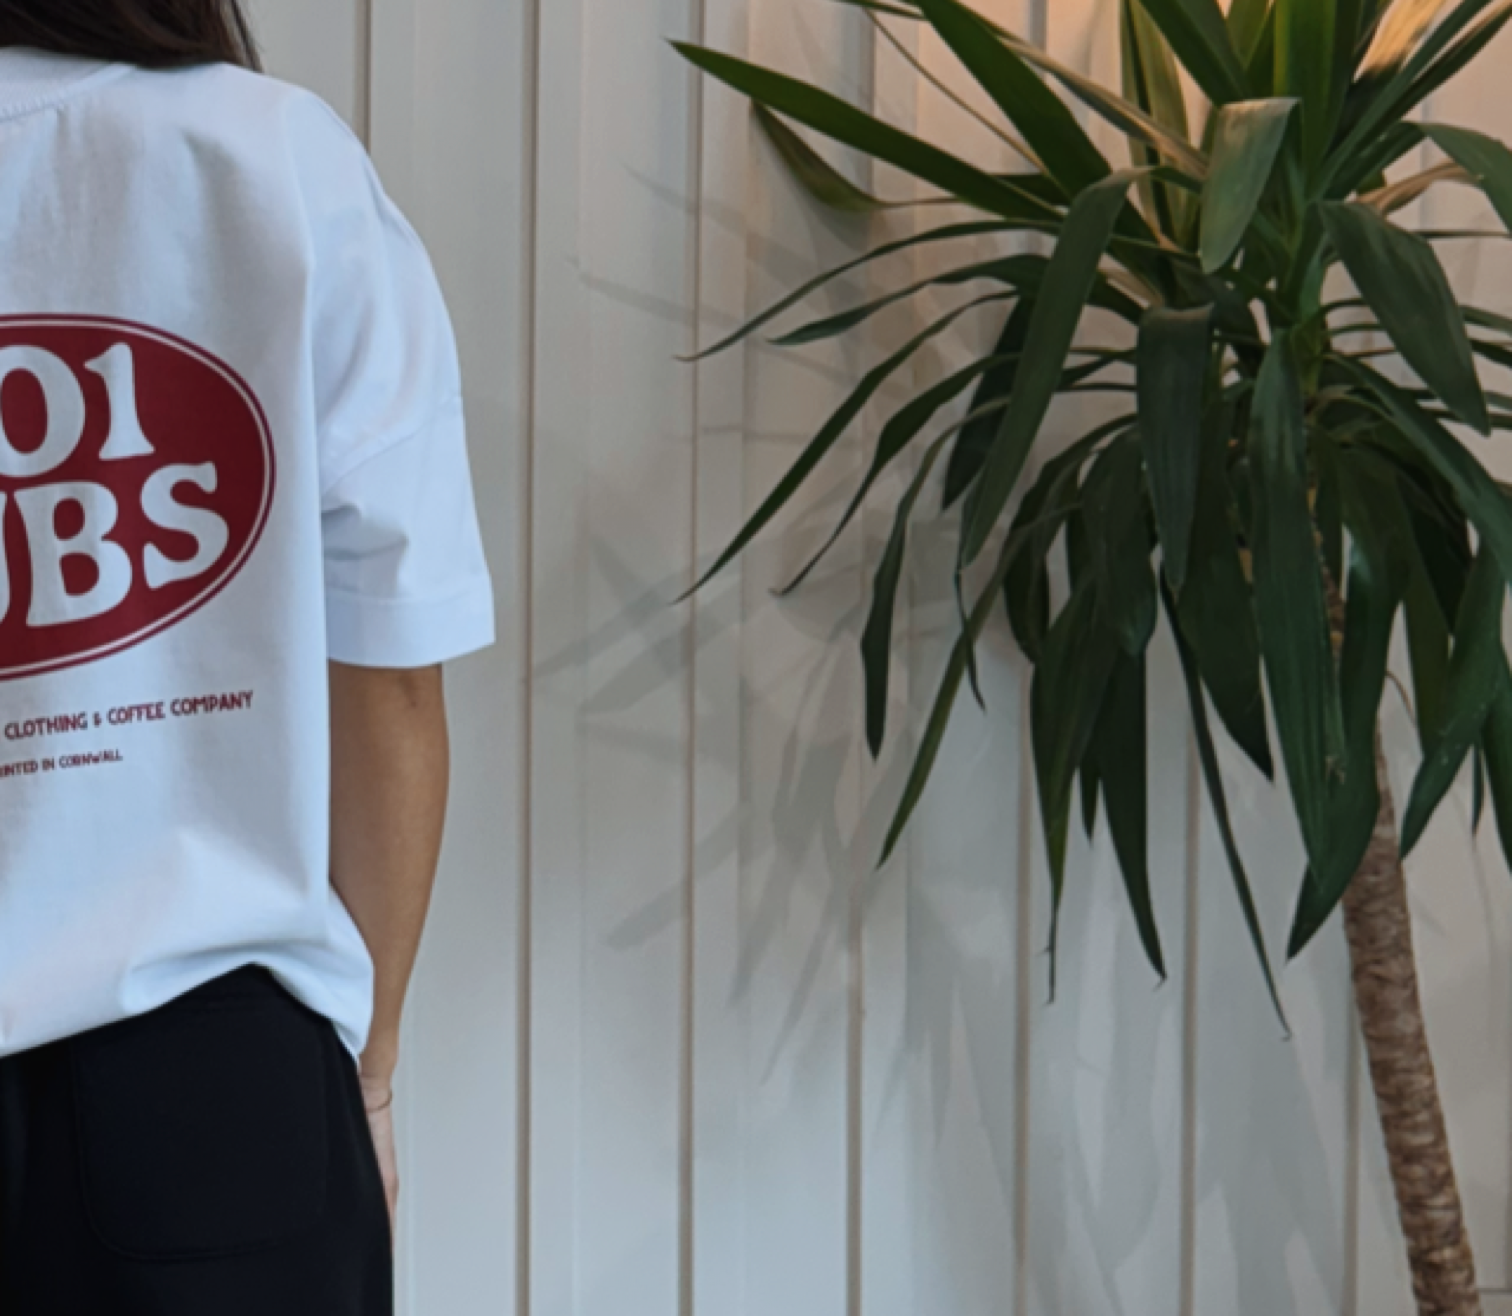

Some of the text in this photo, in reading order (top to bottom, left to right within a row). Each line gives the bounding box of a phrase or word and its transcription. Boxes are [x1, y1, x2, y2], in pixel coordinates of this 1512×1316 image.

[5, 712, 88, 741] CLOTHING
[107, 701, 165, 726] COFFEE
[171, 690, 254, 717] COMPANY
[41, 758, 55, 772] IN
[59, 748, 123, 769] CORNWALL
